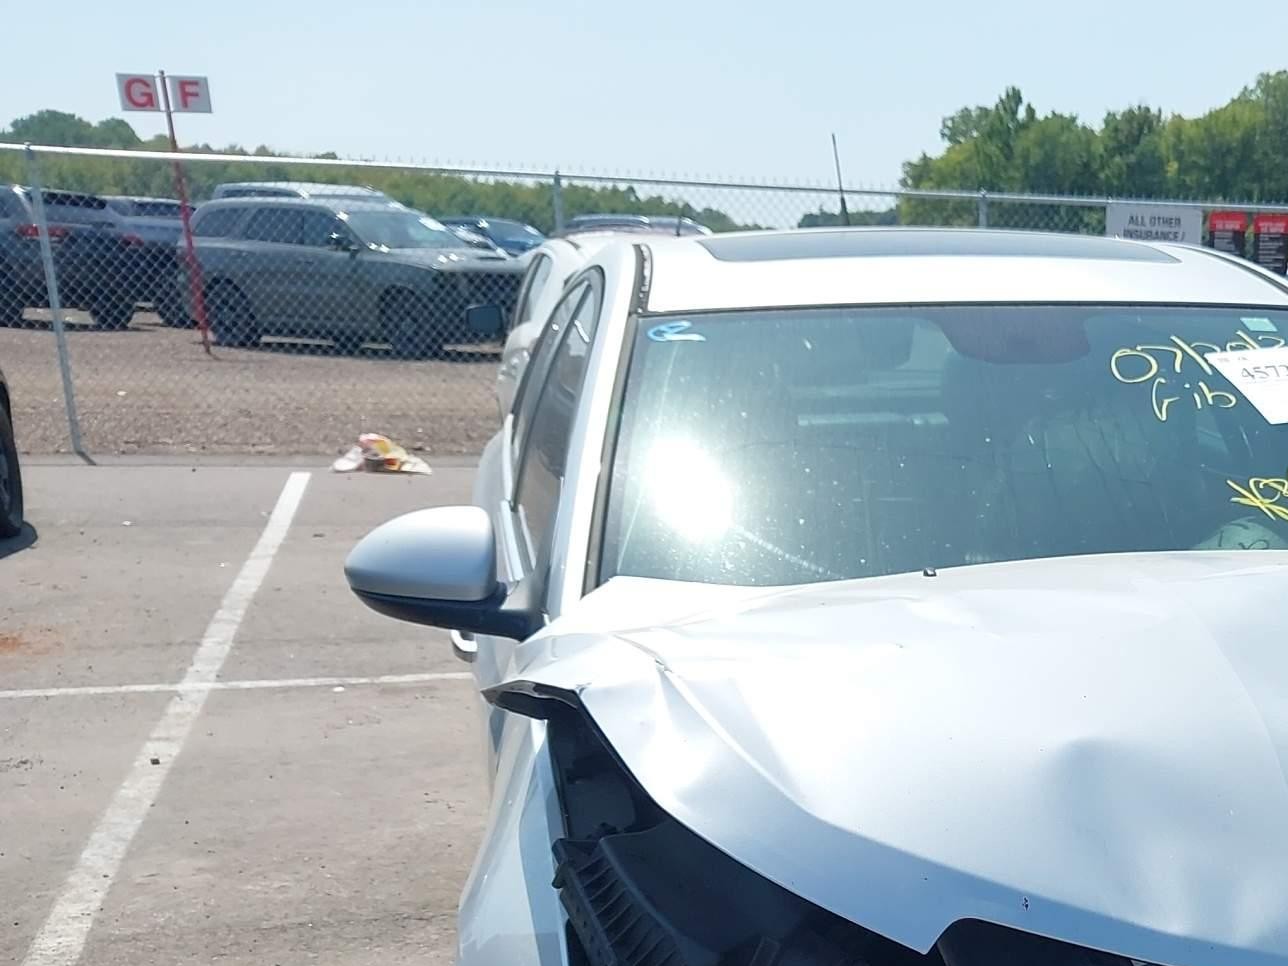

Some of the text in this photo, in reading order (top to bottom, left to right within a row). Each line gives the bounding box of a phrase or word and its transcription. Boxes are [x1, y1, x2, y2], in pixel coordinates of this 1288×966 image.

[124, 77, 200, 108] G F
[1128, 215, 1182, 228] ALL OTHER
[1123, 229, 1179, 242] INSURANCE
